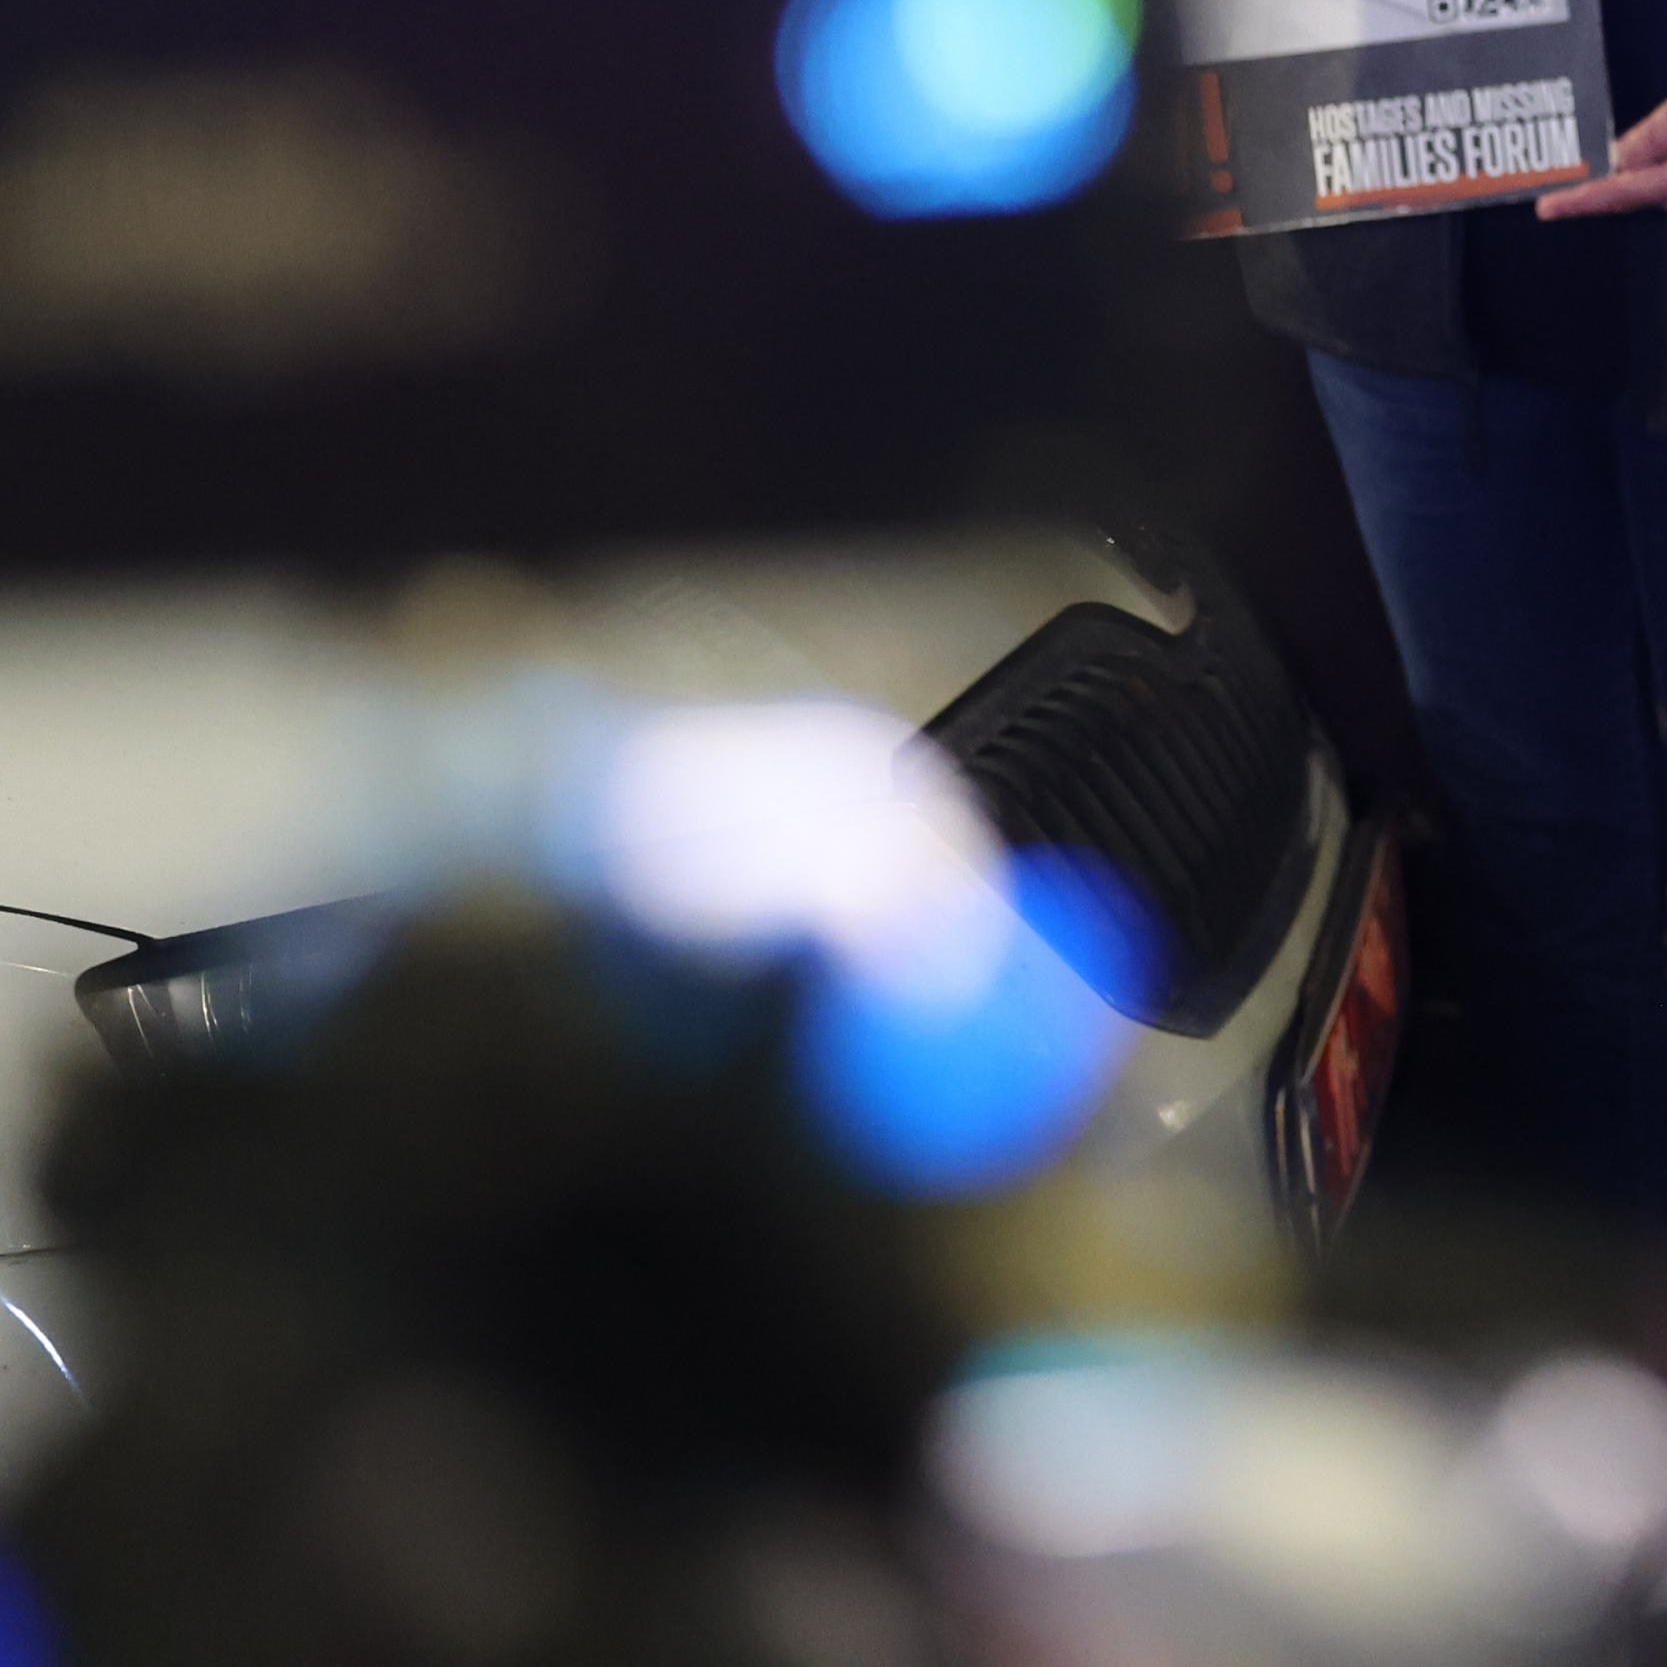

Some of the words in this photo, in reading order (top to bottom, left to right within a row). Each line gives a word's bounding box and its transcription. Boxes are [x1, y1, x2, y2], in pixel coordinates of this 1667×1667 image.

[1308, 95, 1422, 143] HOSTAGES
[1423, 89, 1471, 130] AND
[1471, 77, 1575, 125] MISSING
[1313, 129, 1459, 197] FAMILIES
[1463, 117, 1581, 180] FORUM
